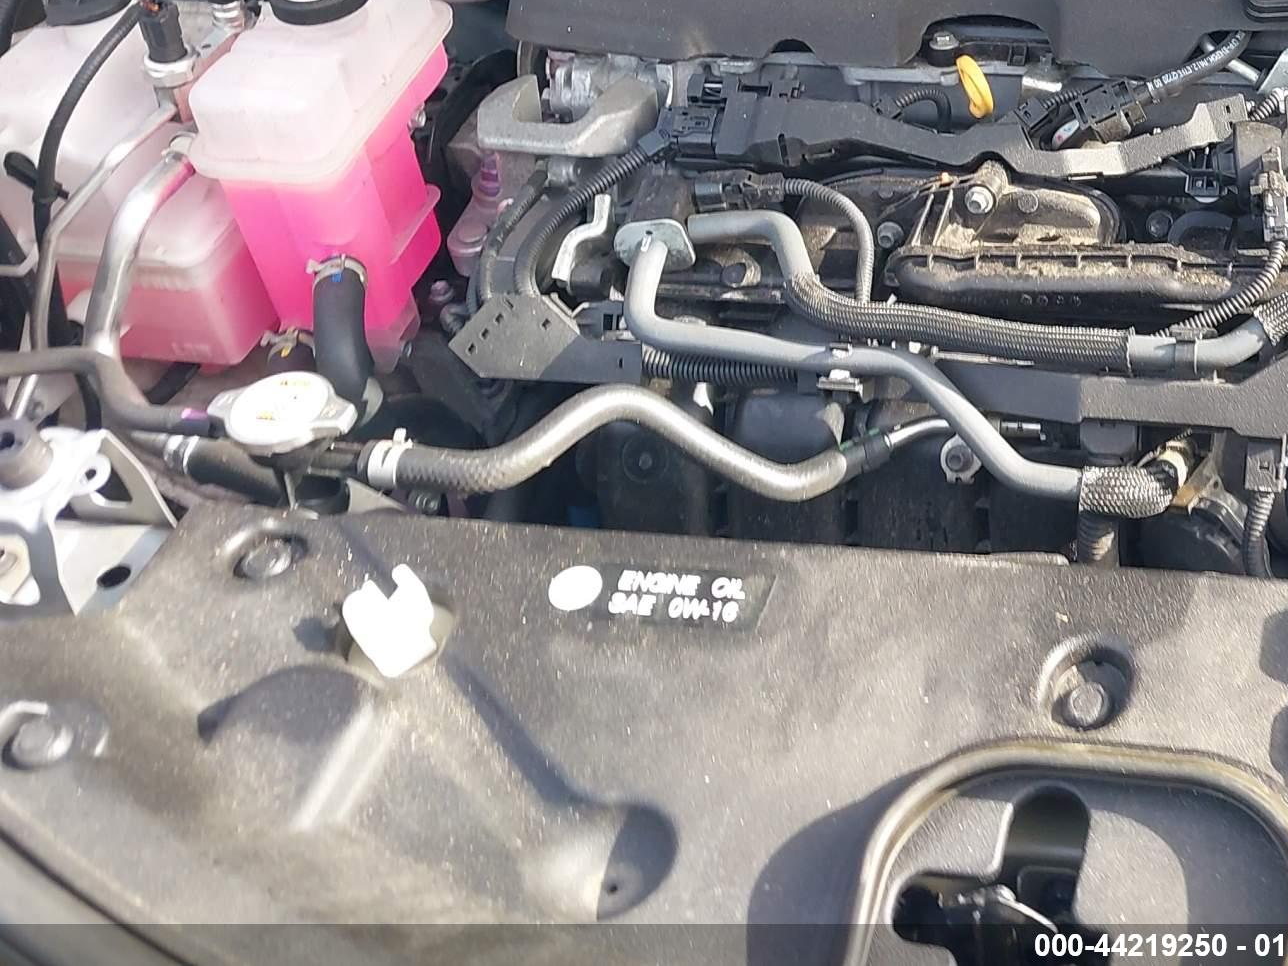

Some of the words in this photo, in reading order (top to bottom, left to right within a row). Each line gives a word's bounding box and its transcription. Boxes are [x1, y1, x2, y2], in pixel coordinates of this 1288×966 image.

[617, 569, 701, 596] ENGINE
[711, 576, 746, 600] OIL
[608, 592, 657, 616] SAE
